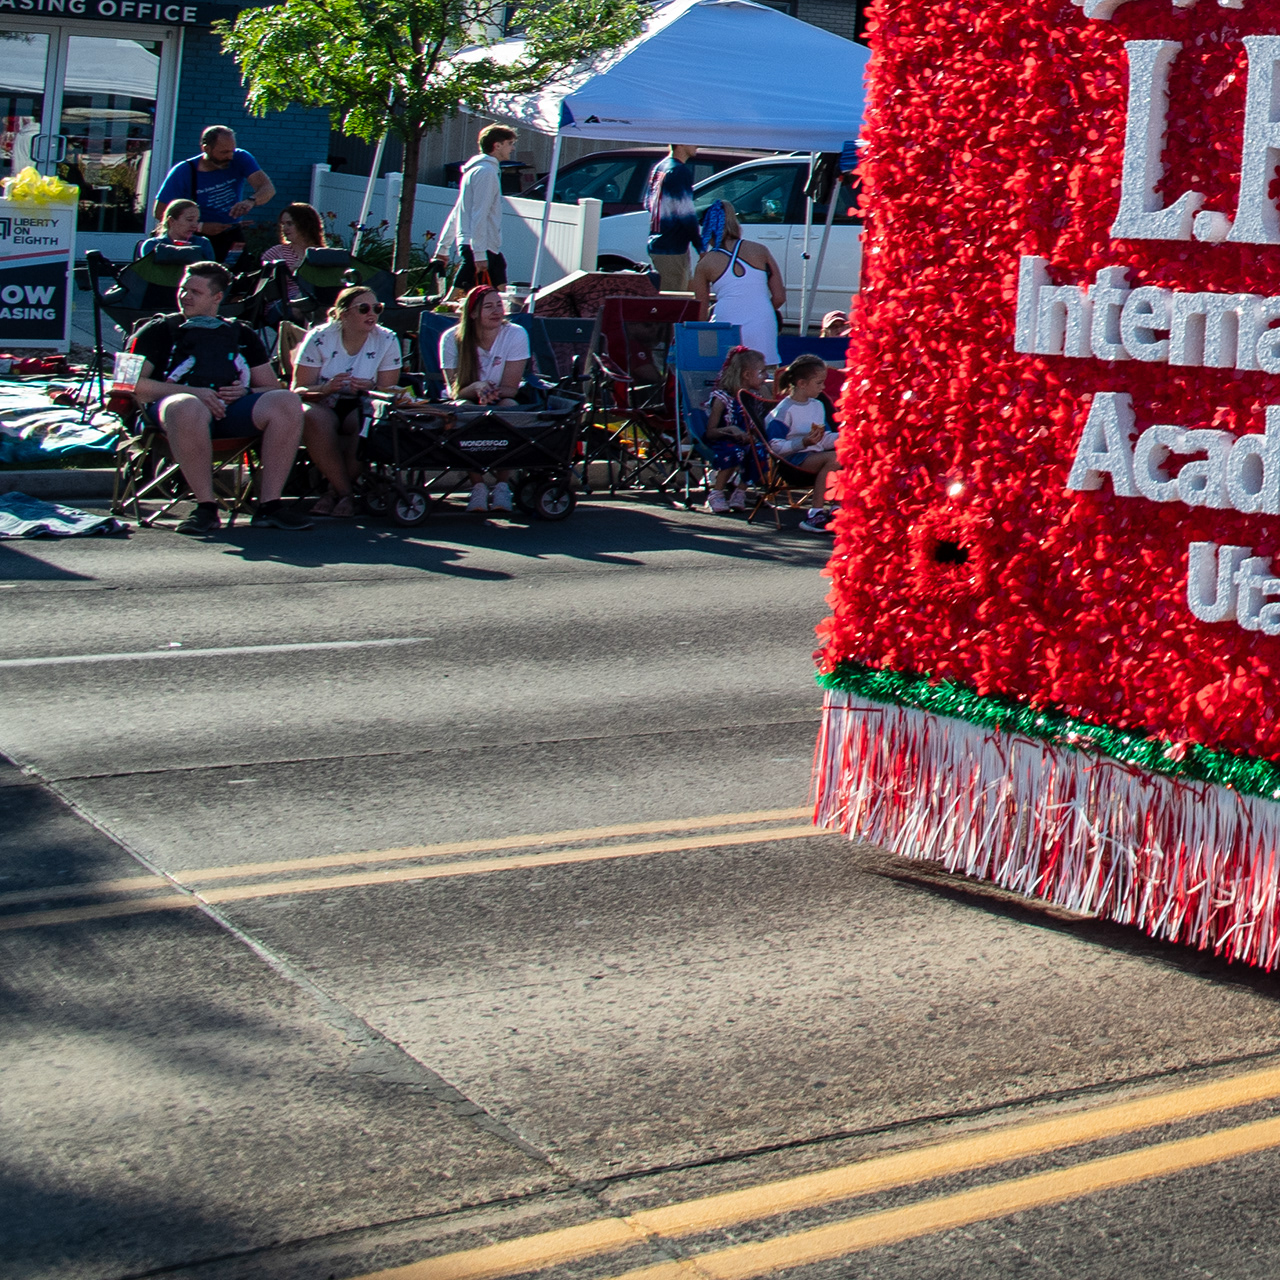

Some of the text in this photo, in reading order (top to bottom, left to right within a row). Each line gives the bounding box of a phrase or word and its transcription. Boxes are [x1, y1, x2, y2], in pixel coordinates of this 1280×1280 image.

[98, 0, 197, 23] OFFICE
[13, 218, 59, 228] LIBERTY
[13, 227, 31, 235] ON
[13, 236, 59, 246] EIGHTH
